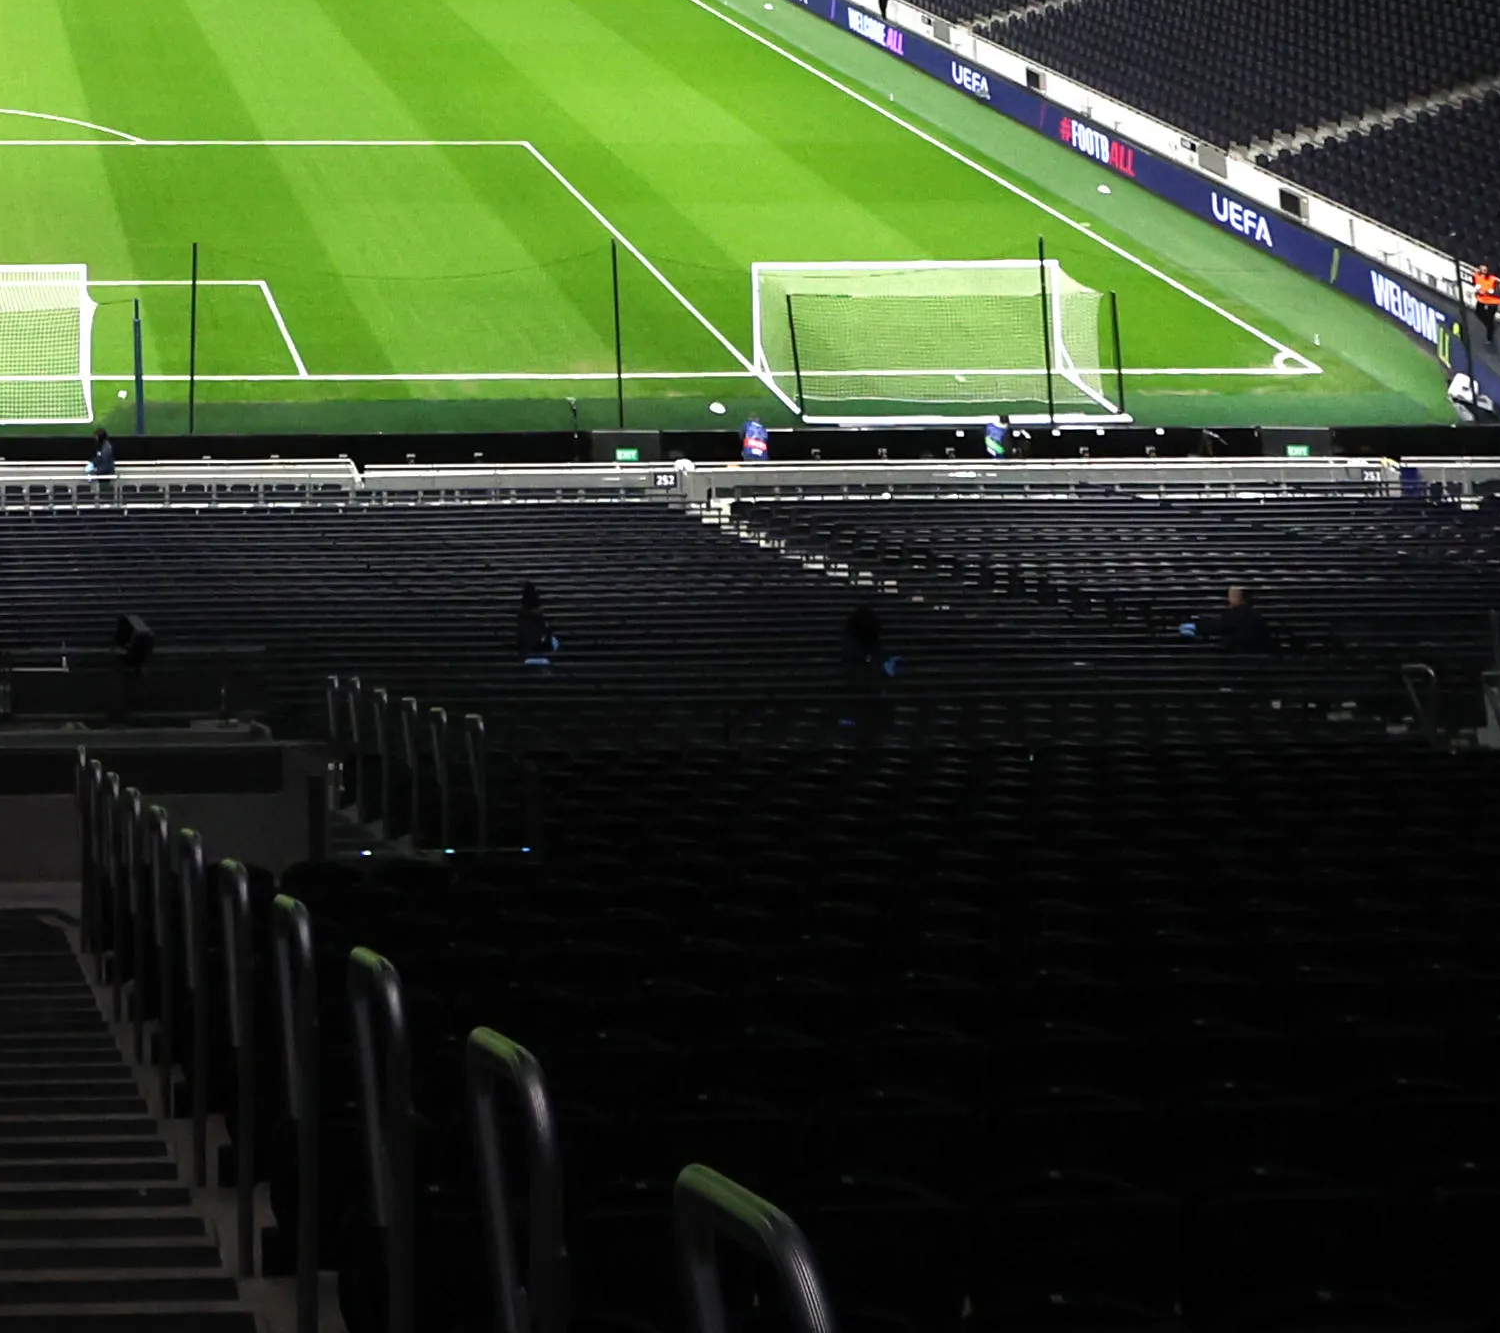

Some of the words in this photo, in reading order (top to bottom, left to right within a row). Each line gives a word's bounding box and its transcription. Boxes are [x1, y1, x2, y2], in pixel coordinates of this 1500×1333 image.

[952, 61, 990, 100] UEFA
[1060, 117, 1135, 177] #FOOTBALL
[1211, 191, 1273, 247] UEFA
[1370, 270, 1446, 344] WELCOM
[656, 474, 675, 485] 252
[1363, 471, 1381, 482] 251
